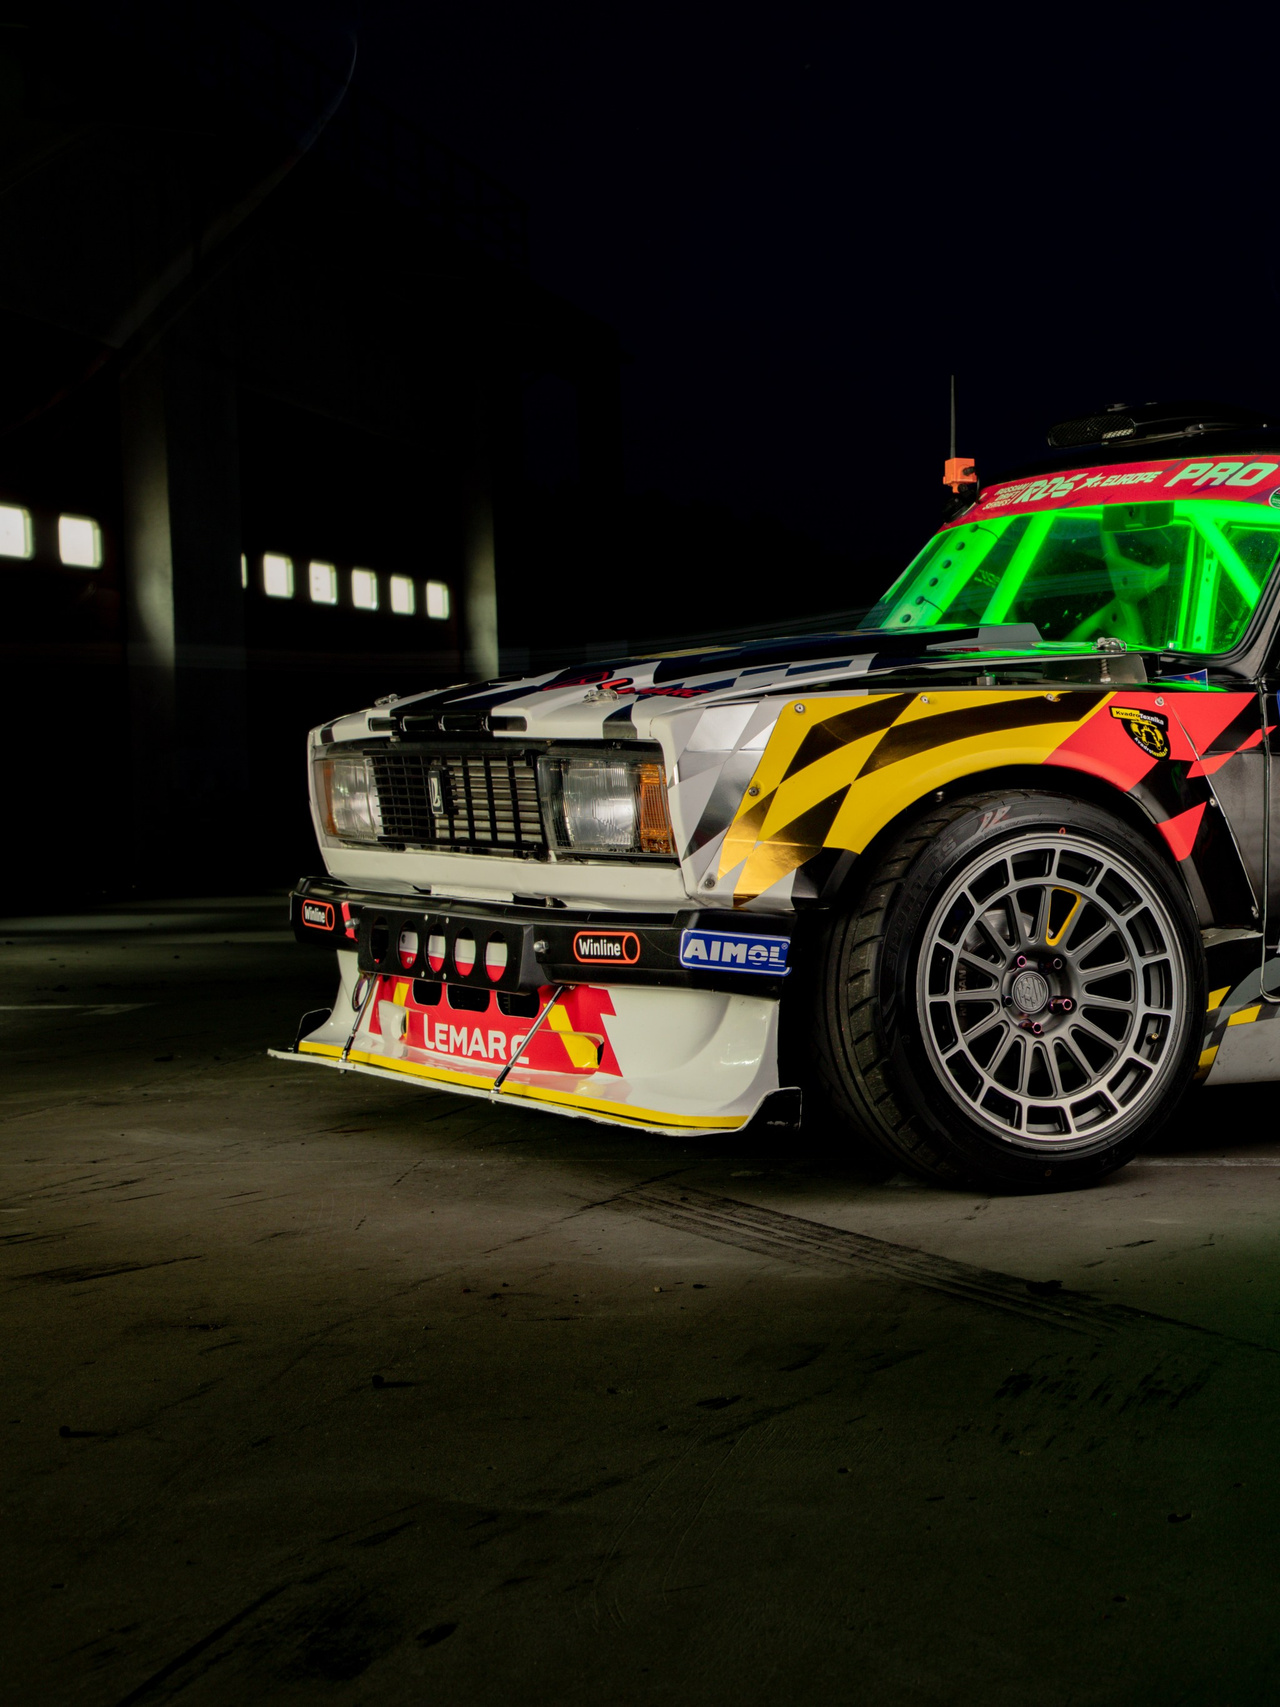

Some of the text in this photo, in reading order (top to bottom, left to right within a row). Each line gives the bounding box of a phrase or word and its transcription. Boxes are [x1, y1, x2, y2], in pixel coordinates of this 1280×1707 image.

[1012, 462, 1279, 504] RDS EUROPE PRO
[302, 904, 327, 926] Winline
[579, 937, 621, 958] Winline
[423, 1015, 531, 1066] LEMARC
